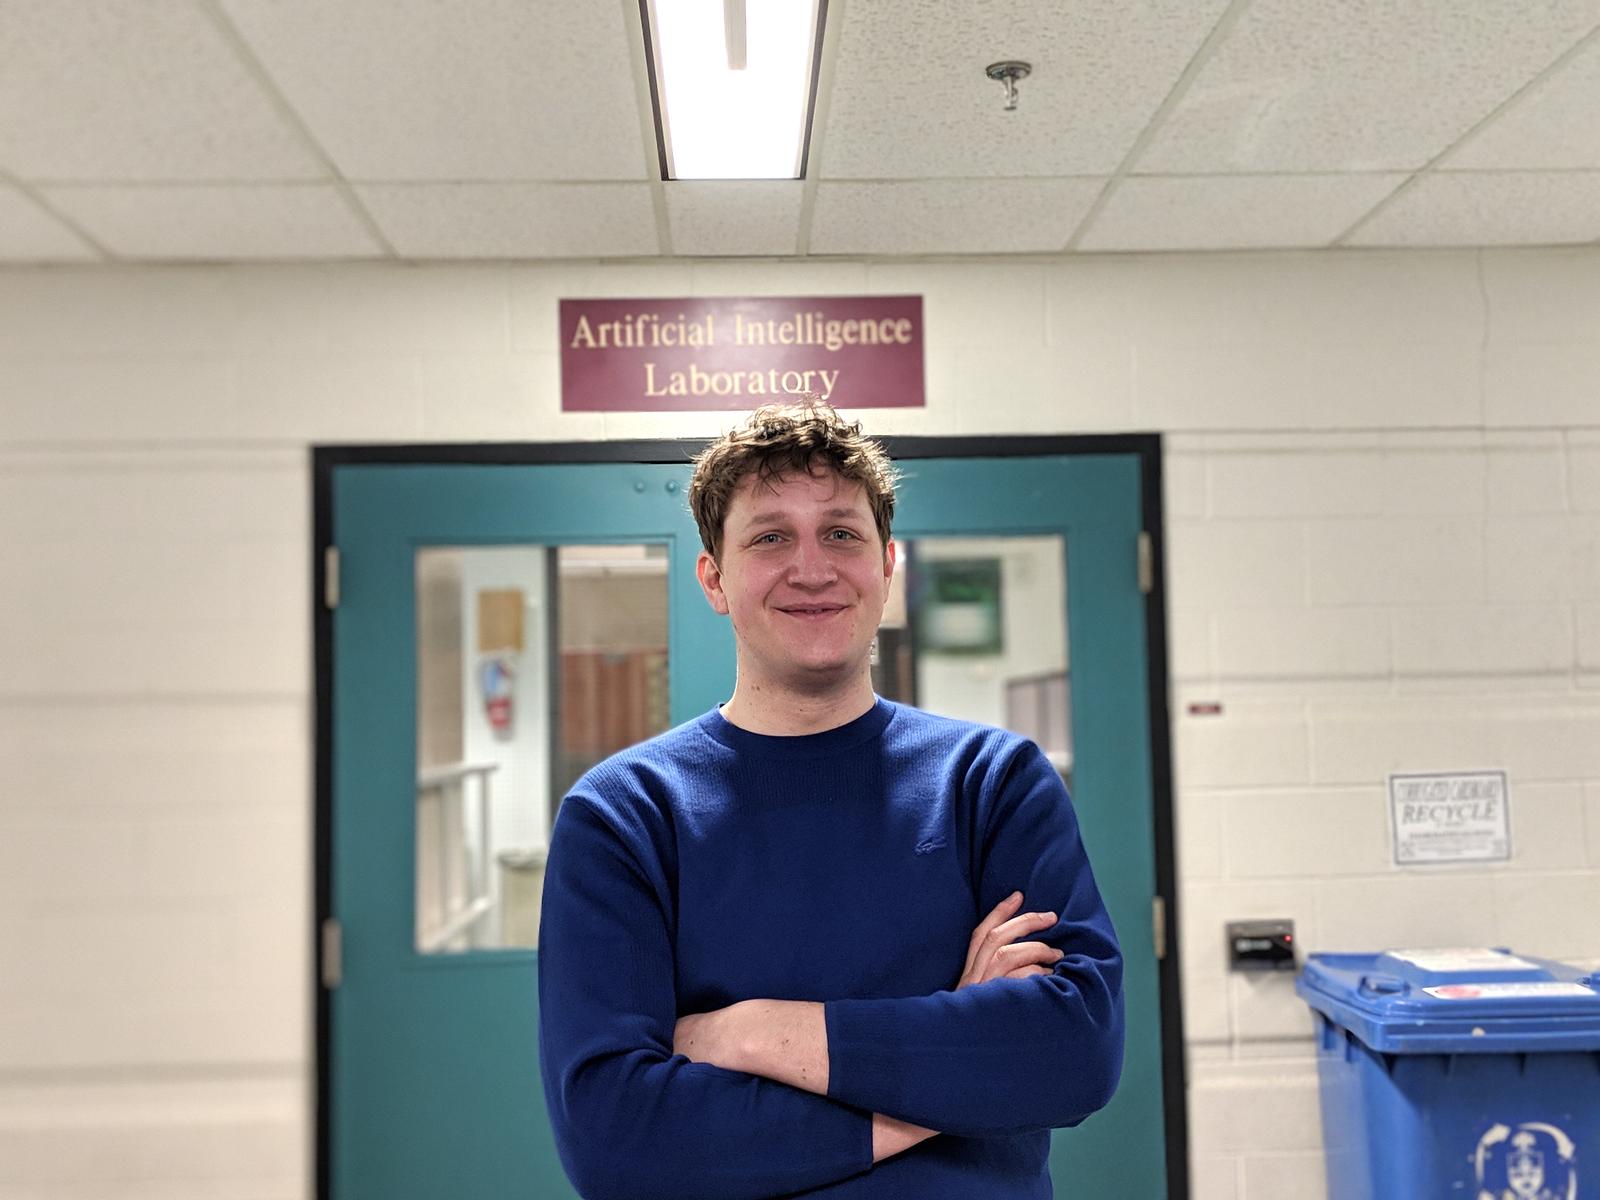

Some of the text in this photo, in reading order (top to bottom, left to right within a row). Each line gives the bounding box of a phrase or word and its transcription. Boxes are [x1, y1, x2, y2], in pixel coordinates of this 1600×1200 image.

[571, 312, 912, 350] Artificial Intelligence
[644, 363, 839, 400] Laboratory
[1402, 801, 1498, 825] RECYCLE
